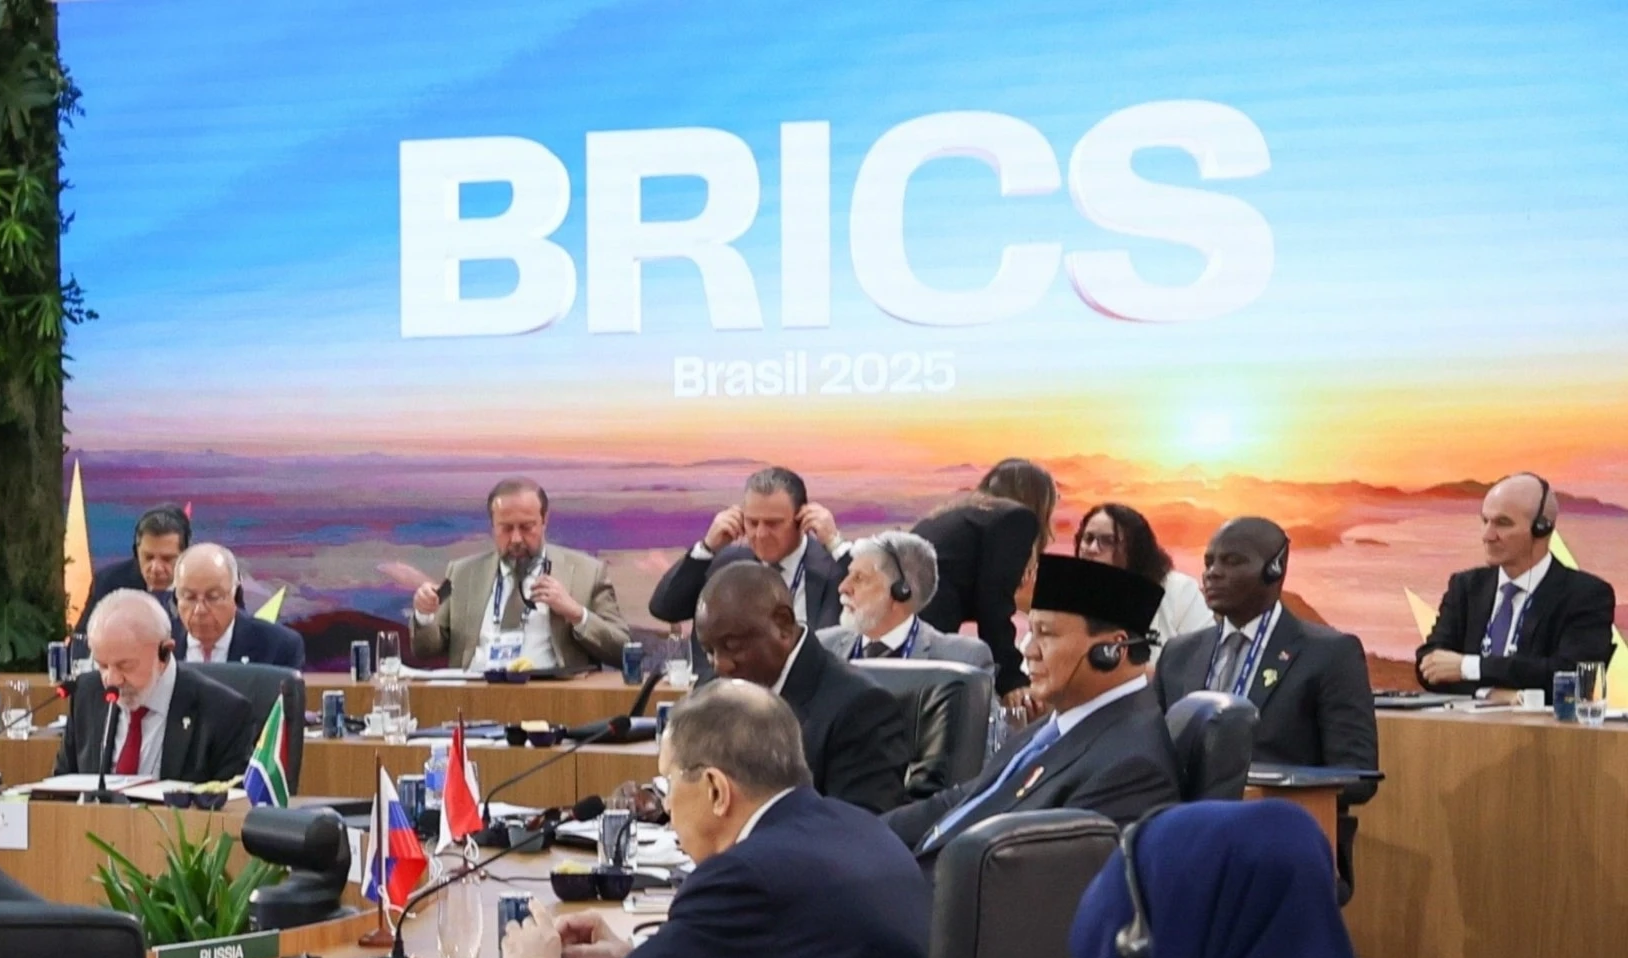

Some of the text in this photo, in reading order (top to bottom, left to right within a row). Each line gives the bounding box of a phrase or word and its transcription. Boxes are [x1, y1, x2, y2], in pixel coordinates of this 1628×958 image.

[399, 99, 1275, 338] BRICS
[673, 350, 957, 398] Brasil 2025
